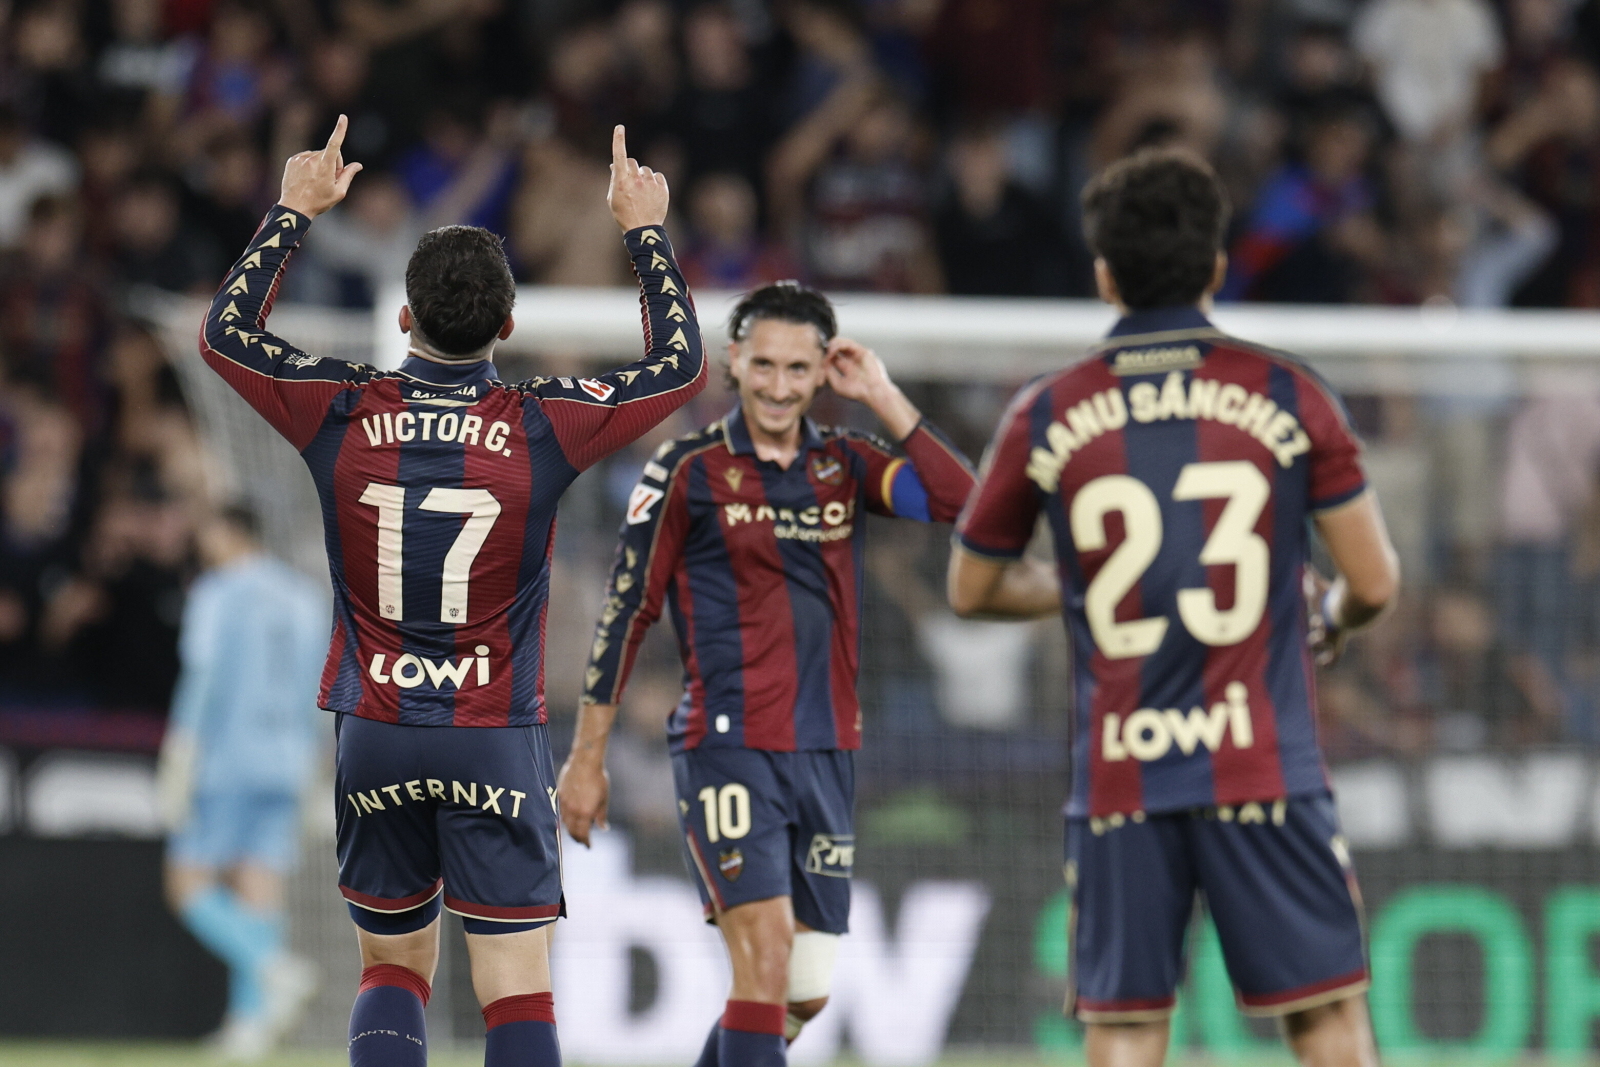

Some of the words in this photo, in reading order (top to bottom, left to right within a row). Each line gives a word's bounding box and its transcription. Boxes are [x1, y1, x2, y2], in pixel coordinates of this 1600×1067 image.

[361, 412, 483, 447] VICTOR
[484, 420, 512, 458] G.
[1026, 386, 1129, 493] MANU
[1128, 369, 1312, 468] SÁNCHEZ
[357, 482, 502, 624] 17
[1069, 459, 1271, 661] 23
[347, 778, 527, 818] INTERNXT
[697, 782, 752, 844] 10
